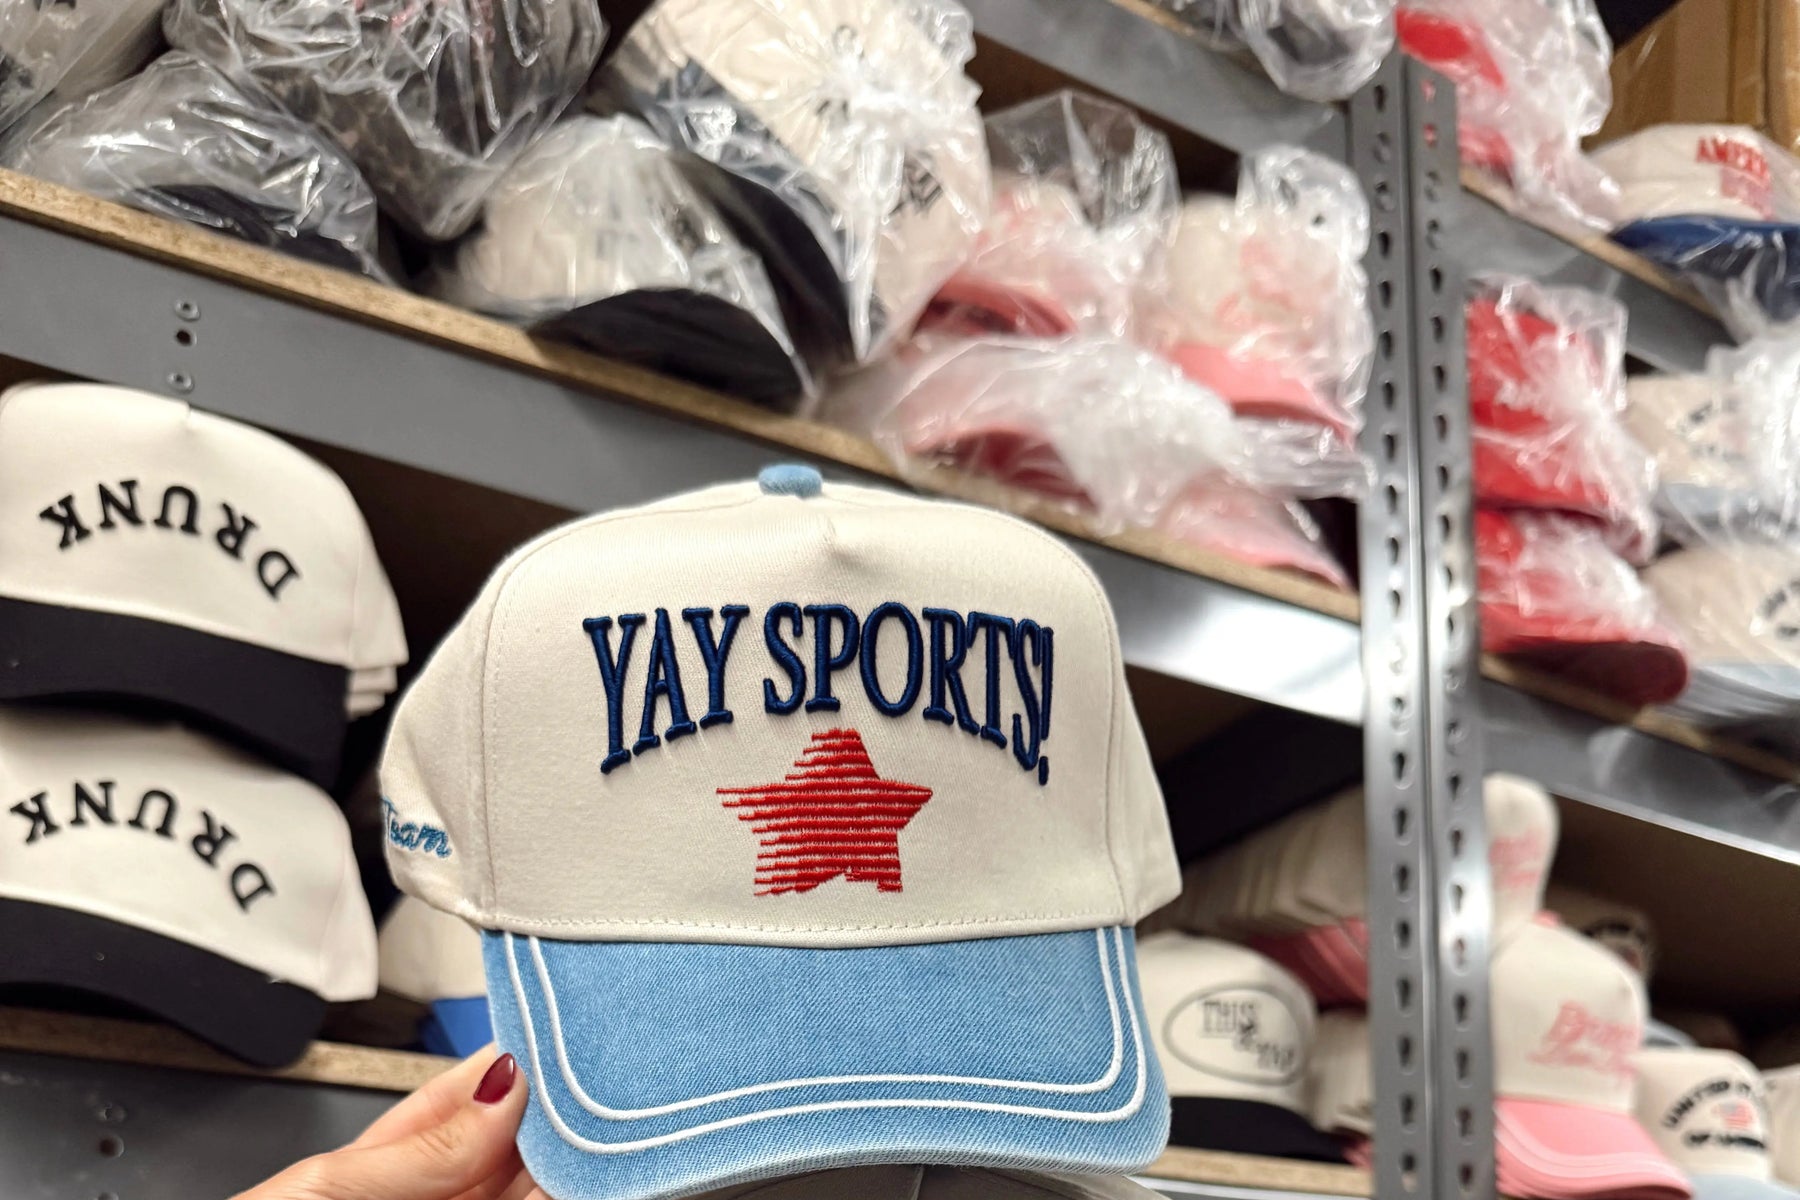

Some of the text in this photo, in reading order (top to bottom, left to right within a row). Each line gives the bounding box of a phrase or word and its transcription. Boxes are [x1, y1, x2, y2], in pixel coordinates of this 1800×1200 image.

[39, 479, 302, 601] DRUNK
[582, 601, 1054, 786] YAY SPORTS!
[9, 780, 277, 914] DRUNK
